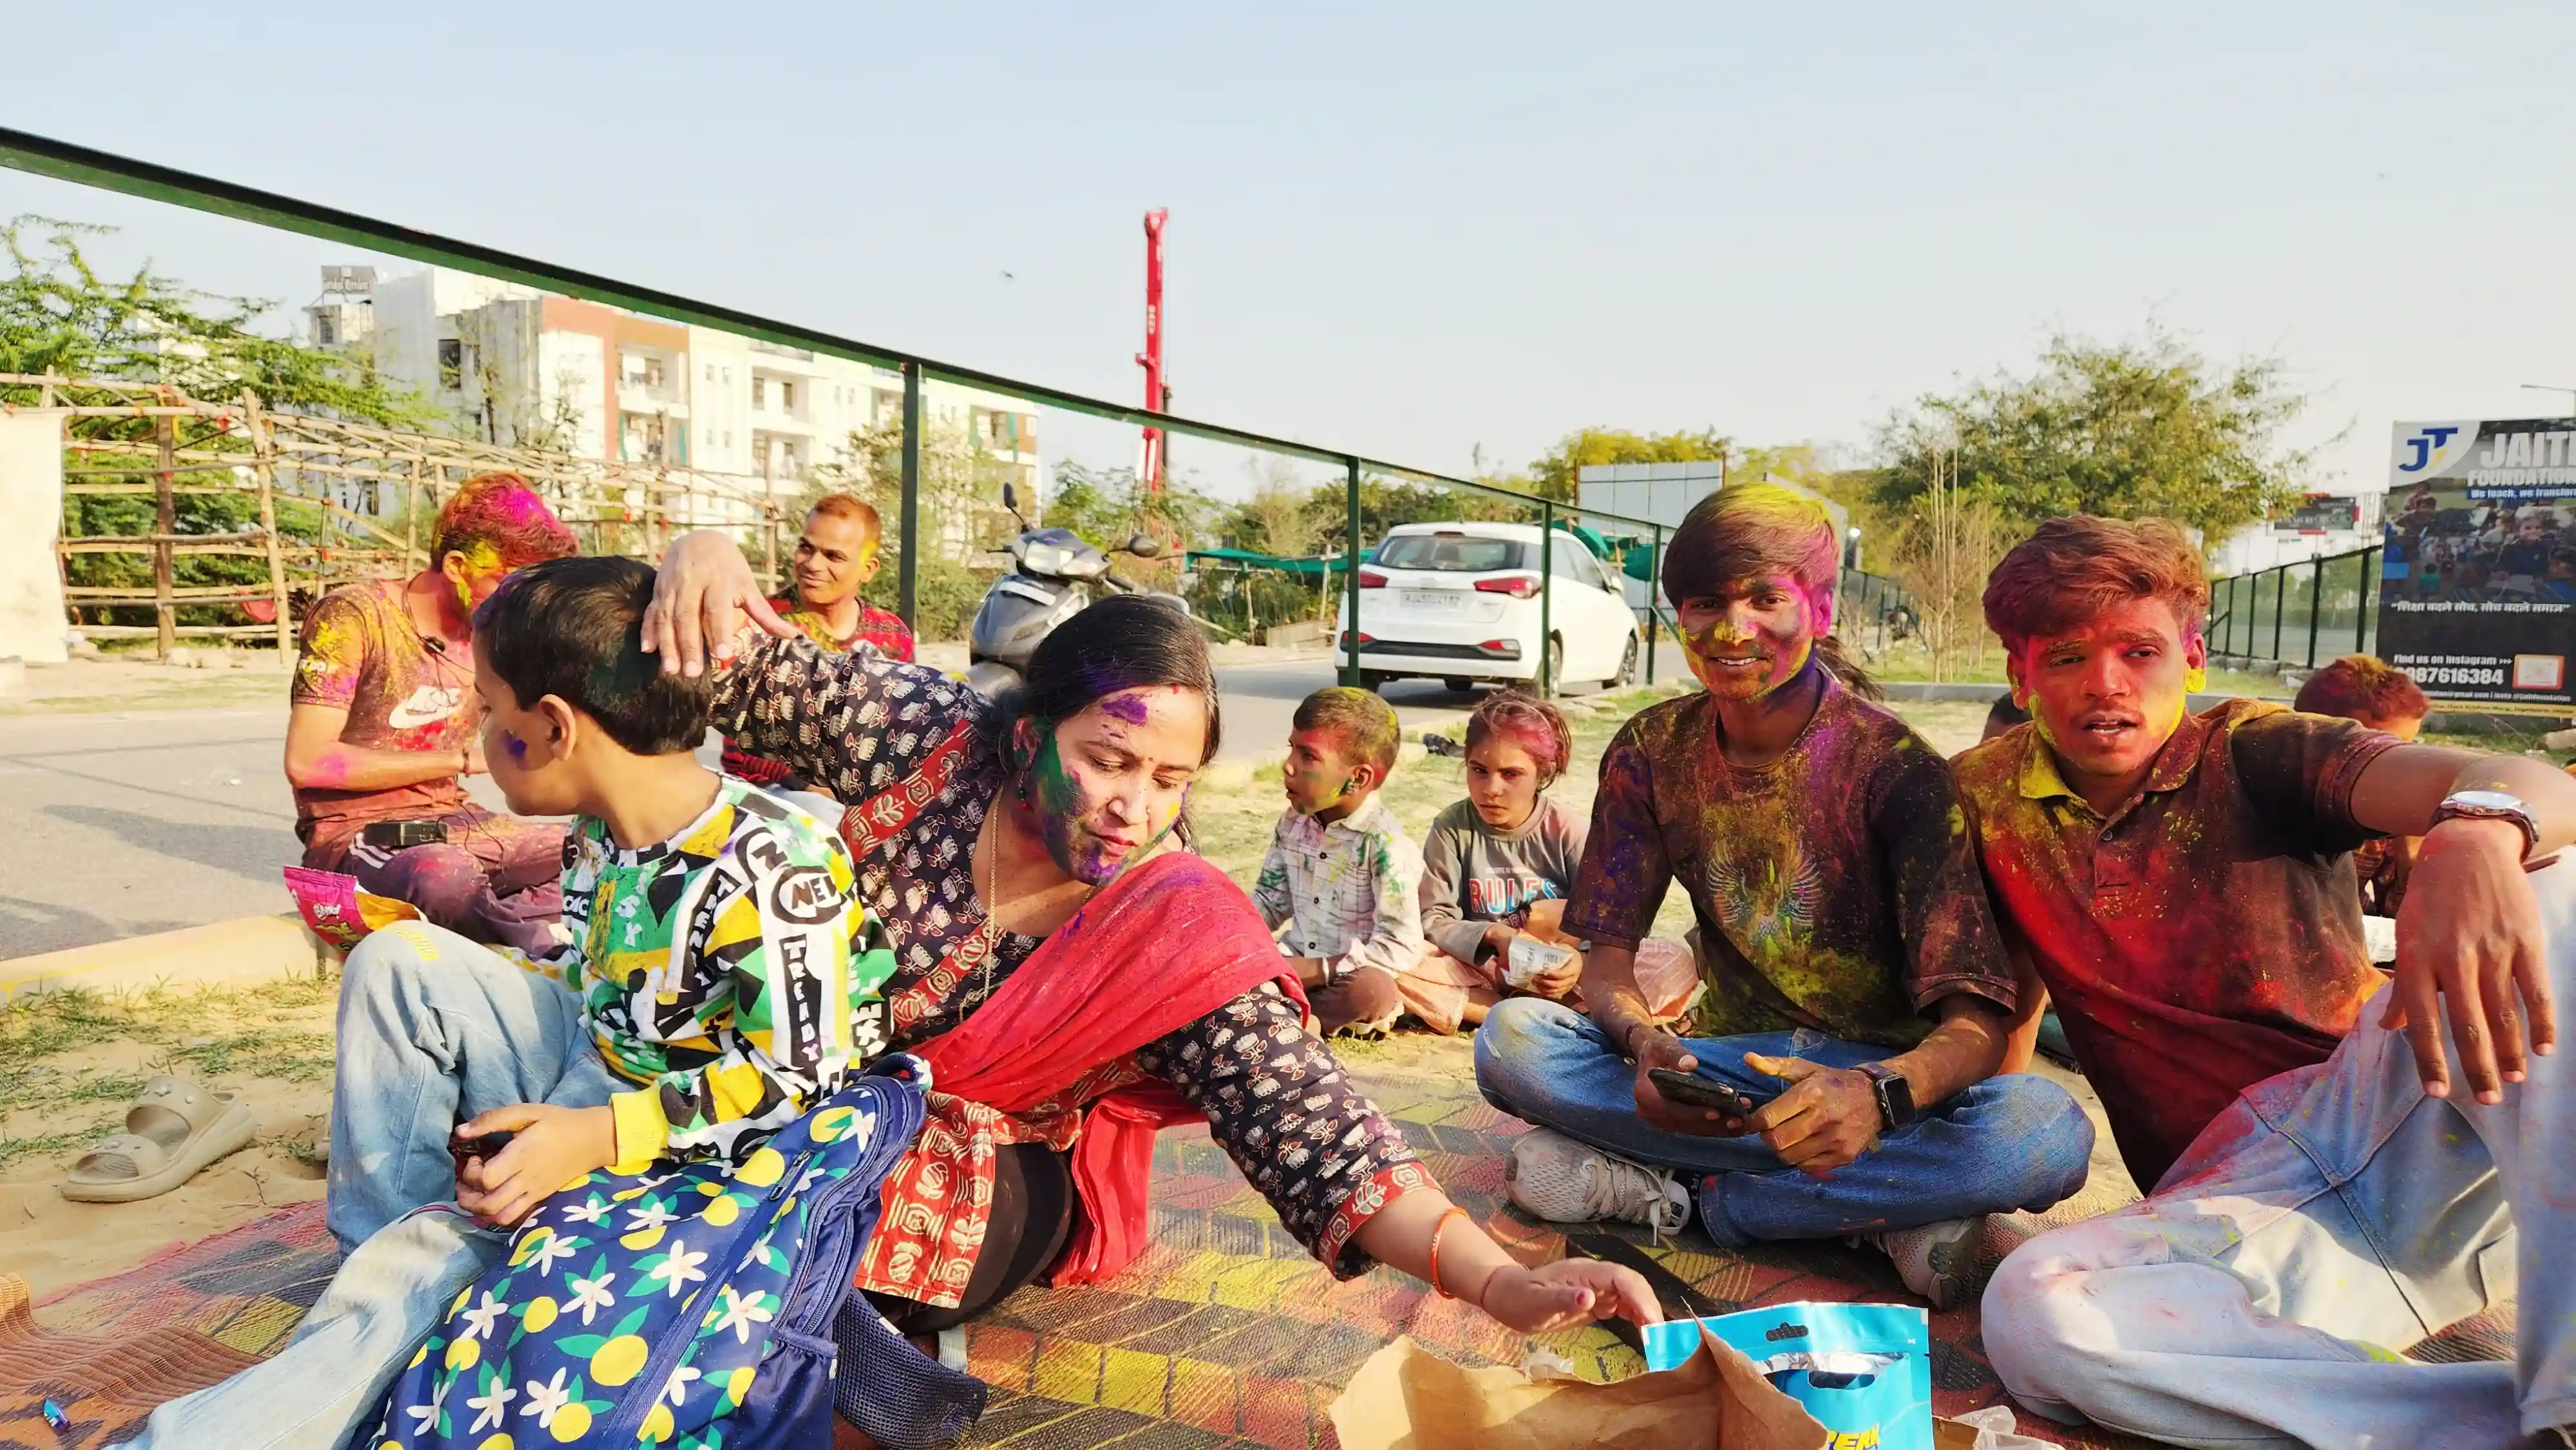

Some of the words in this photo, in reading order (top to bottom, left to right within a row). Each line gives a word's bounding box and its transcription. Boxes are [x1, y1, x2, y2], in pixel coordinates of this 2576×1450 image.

[2471, 489, 2486, 498] We
[2519, 489, 2535, 498] we
[2394, 654, 2415, 664] Find
[2416, 655, 2429, 664] us
[2430, 655, 2444, 664] on
[2446, 655, 2497, 666] Instagram
